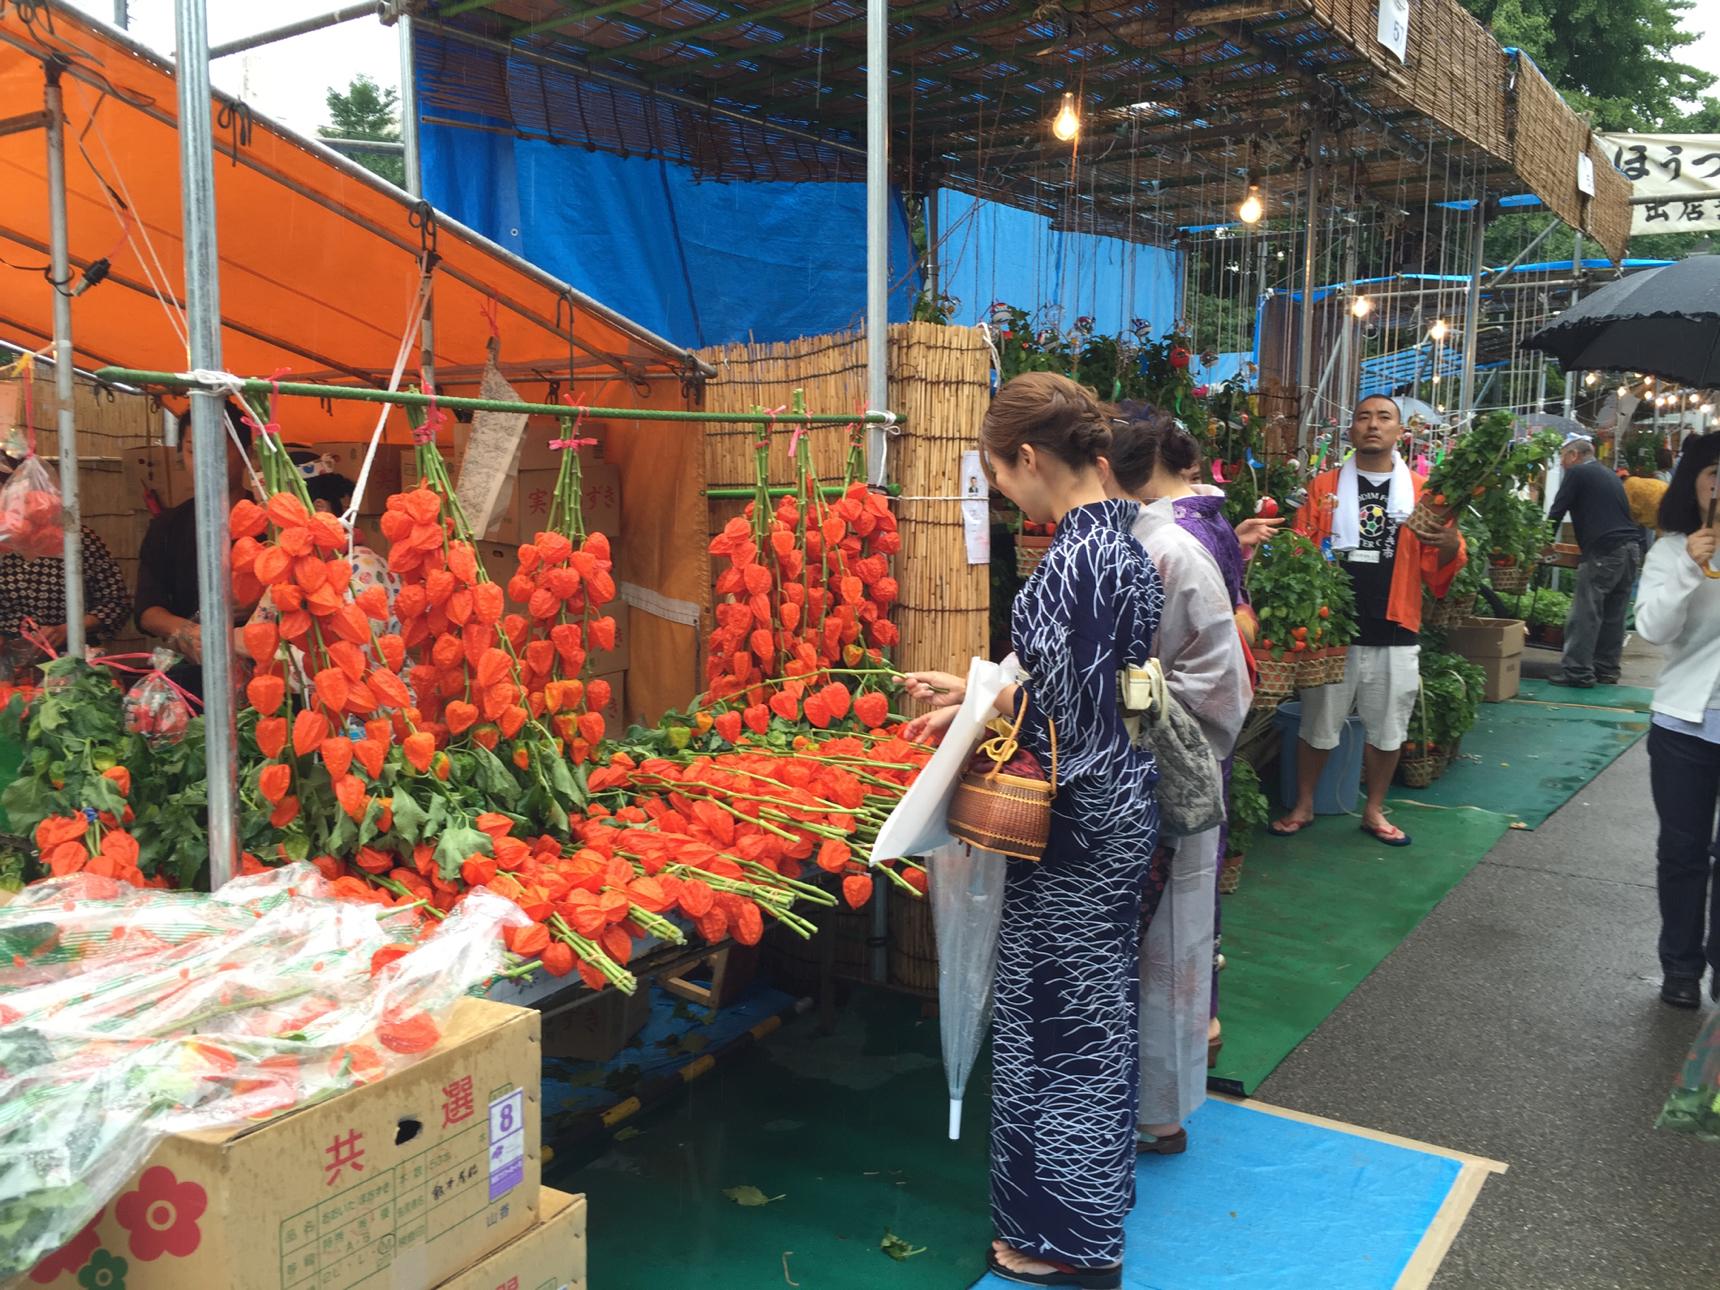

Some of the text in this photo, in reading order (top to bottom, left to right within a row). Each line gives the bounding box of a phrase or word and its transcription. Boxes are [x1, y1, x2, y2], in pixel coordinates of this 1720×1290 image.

[1645, 202, 1720, 223] 出店
[324, 1074, 475, 1186] 共 選
[500, 1103, 513, 1133] 8
